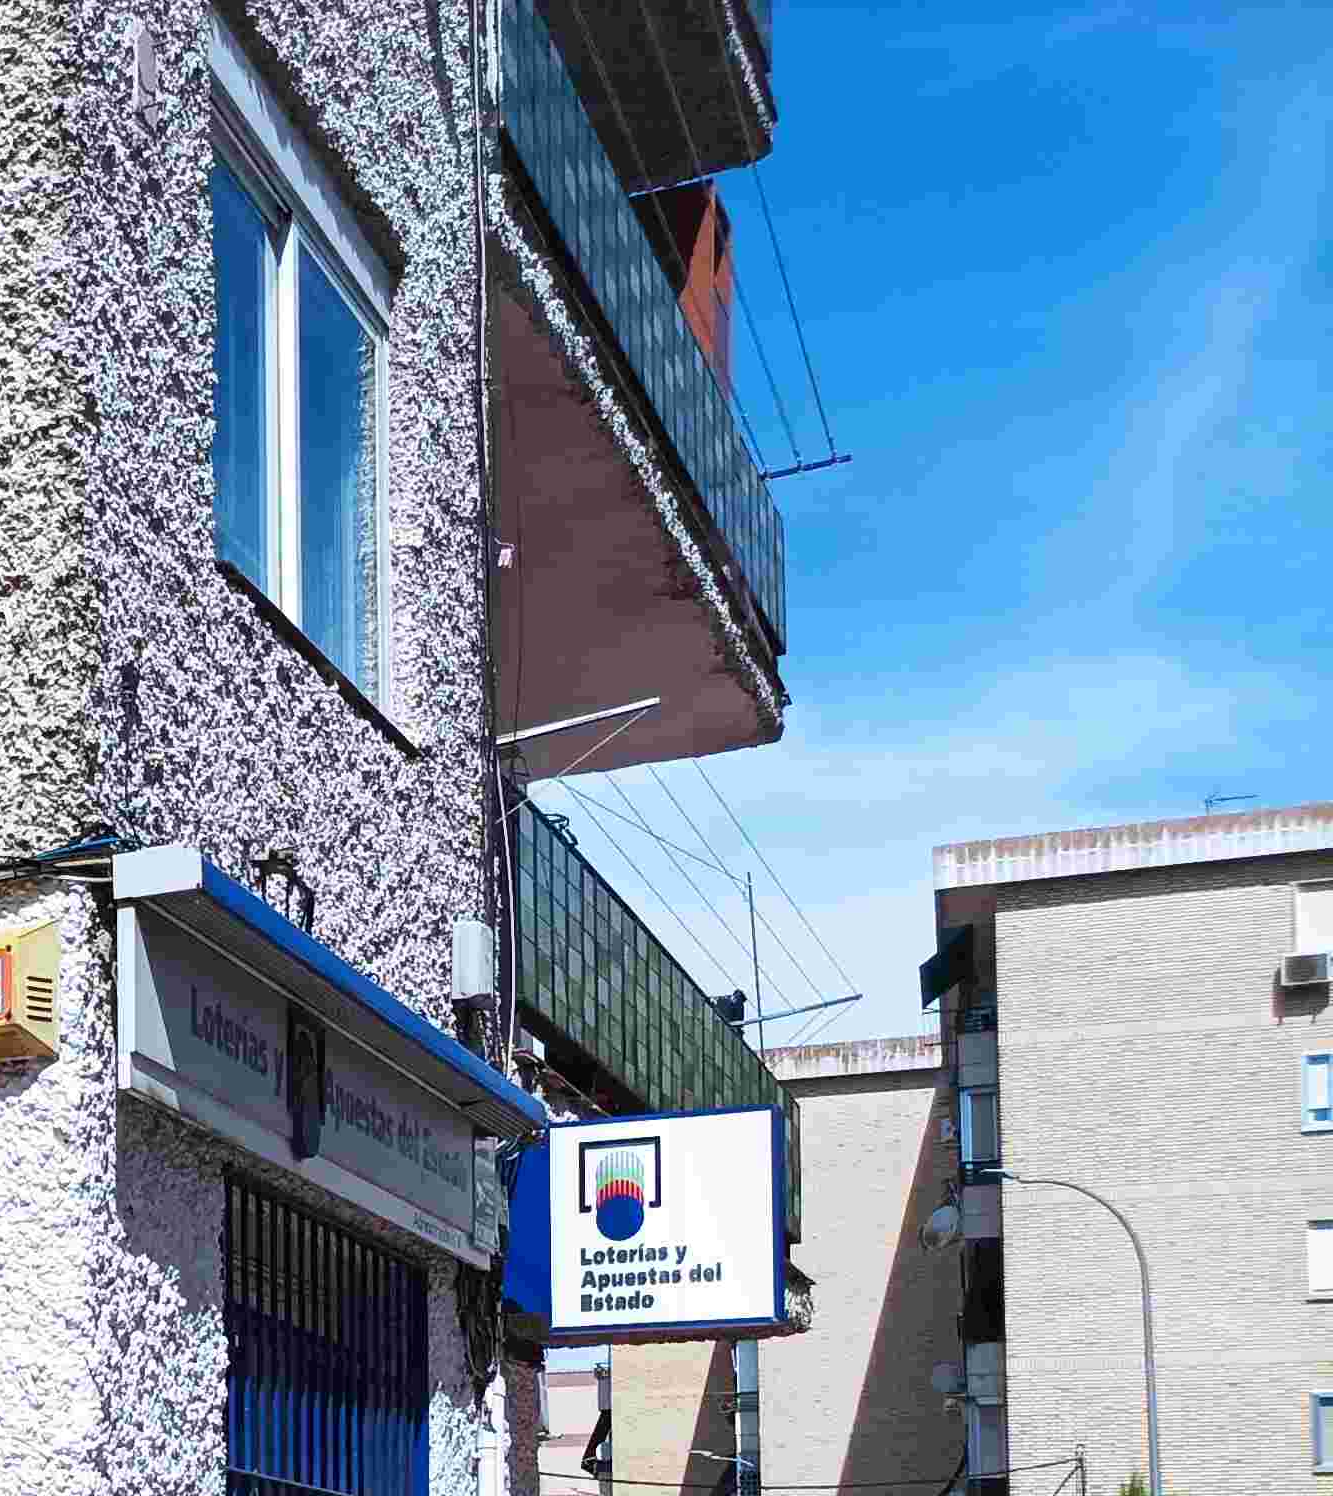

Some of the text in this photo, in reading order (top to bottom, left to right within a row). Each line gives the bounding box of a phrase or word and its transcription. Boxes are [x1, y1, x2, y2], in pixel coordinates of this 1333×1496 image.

[190, 983, 269, 1080] Loterías
[580, 1243, 688, 1267] Loterías y
[580, 1263, 723, 1293] Apuestas del
[580, 1290, 655, 1313] Estado
